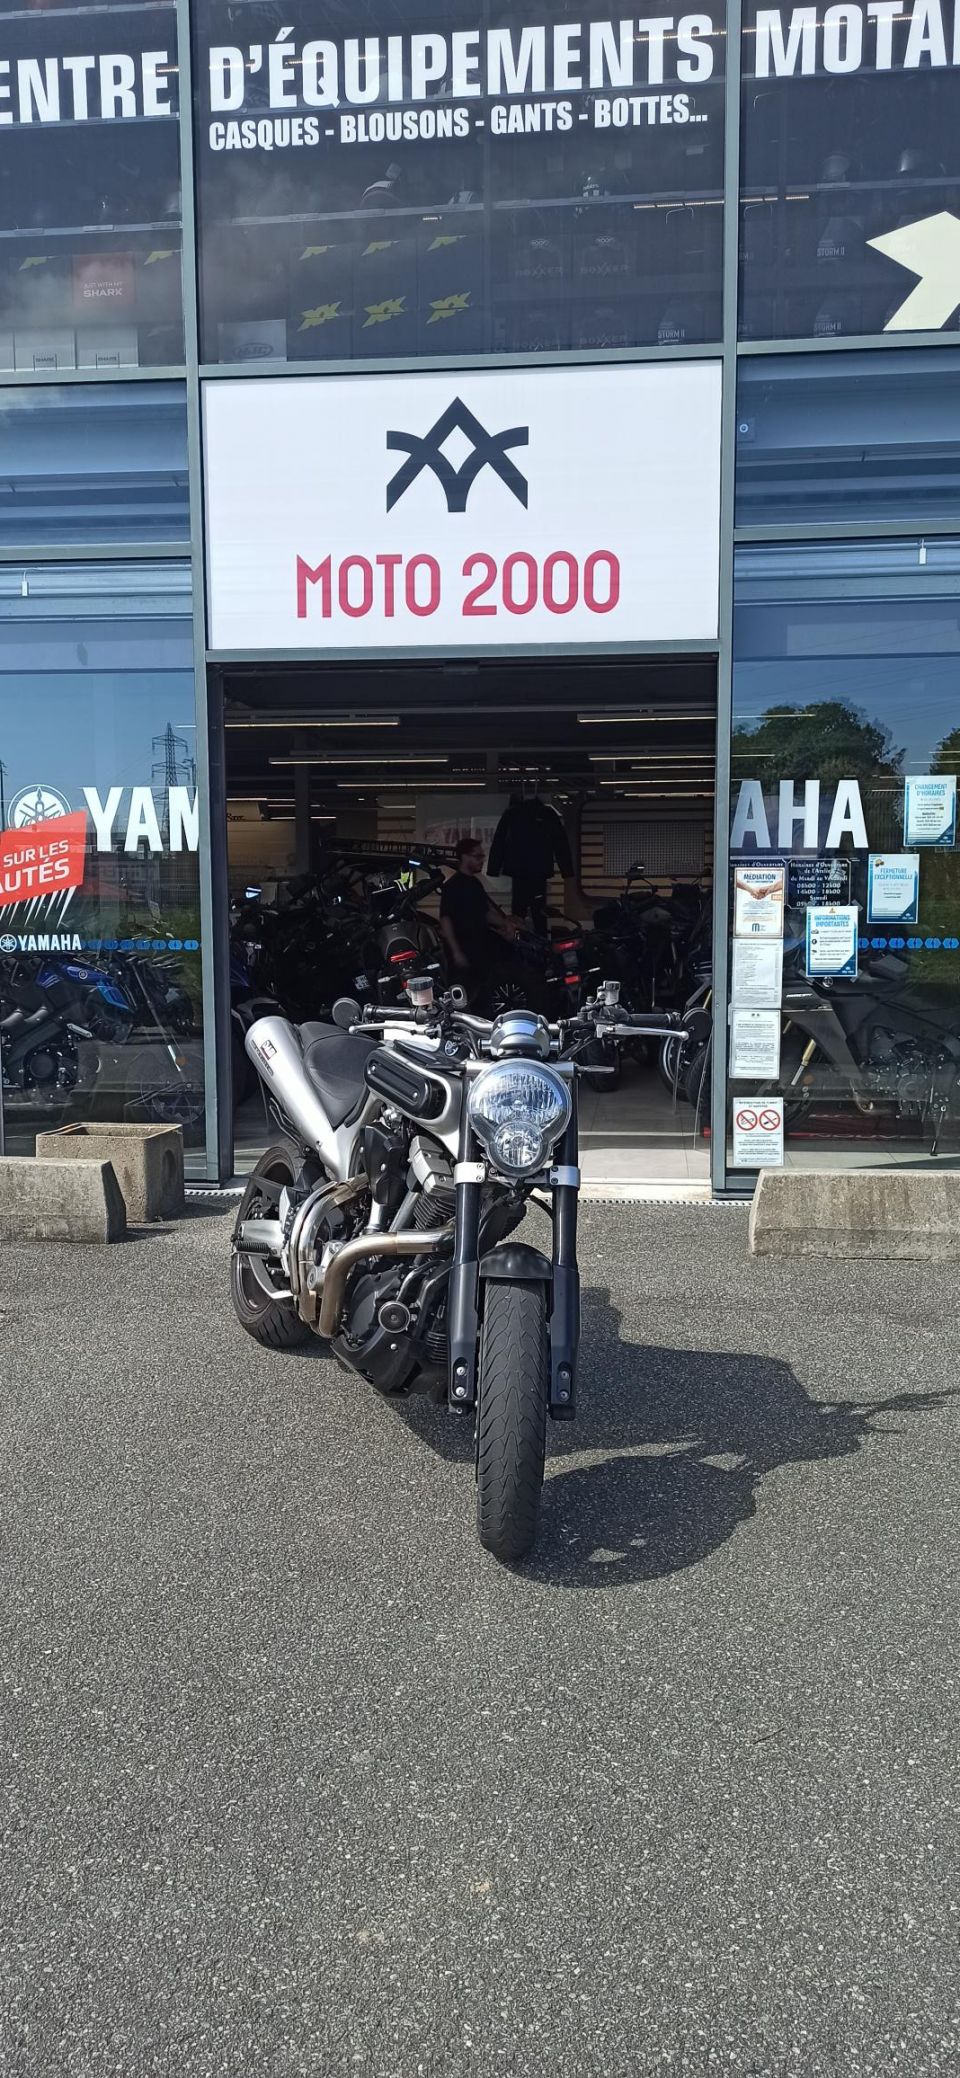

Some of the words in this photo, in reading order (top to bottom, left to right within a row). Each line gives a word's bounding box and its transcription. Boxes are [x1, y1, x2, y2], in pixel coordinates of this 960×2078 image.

[209, 14, 714, 112] D'ÉQUIPEMENTS
[755, 0, 960, 78] MOTA
[209, 117, 319, 150] CASQUES
[340, 108, 469, 143] BLOUSONS
[490, 101, 573, 135] GANTS
[594, 94, 708, 128] BOTTES...
[817, 247, 839, 256] STORM
[83, 288, 122, 297] SHARK
[296, 553, 441, 618] MOTO
[462, 549, 620, 616] 2000
[730, 779, 869, 848] AHA
[3, 848, 36, 868] SUR
[39, 840, 69, 859] LES
[18, 934, 82, 951] YAMAHA
